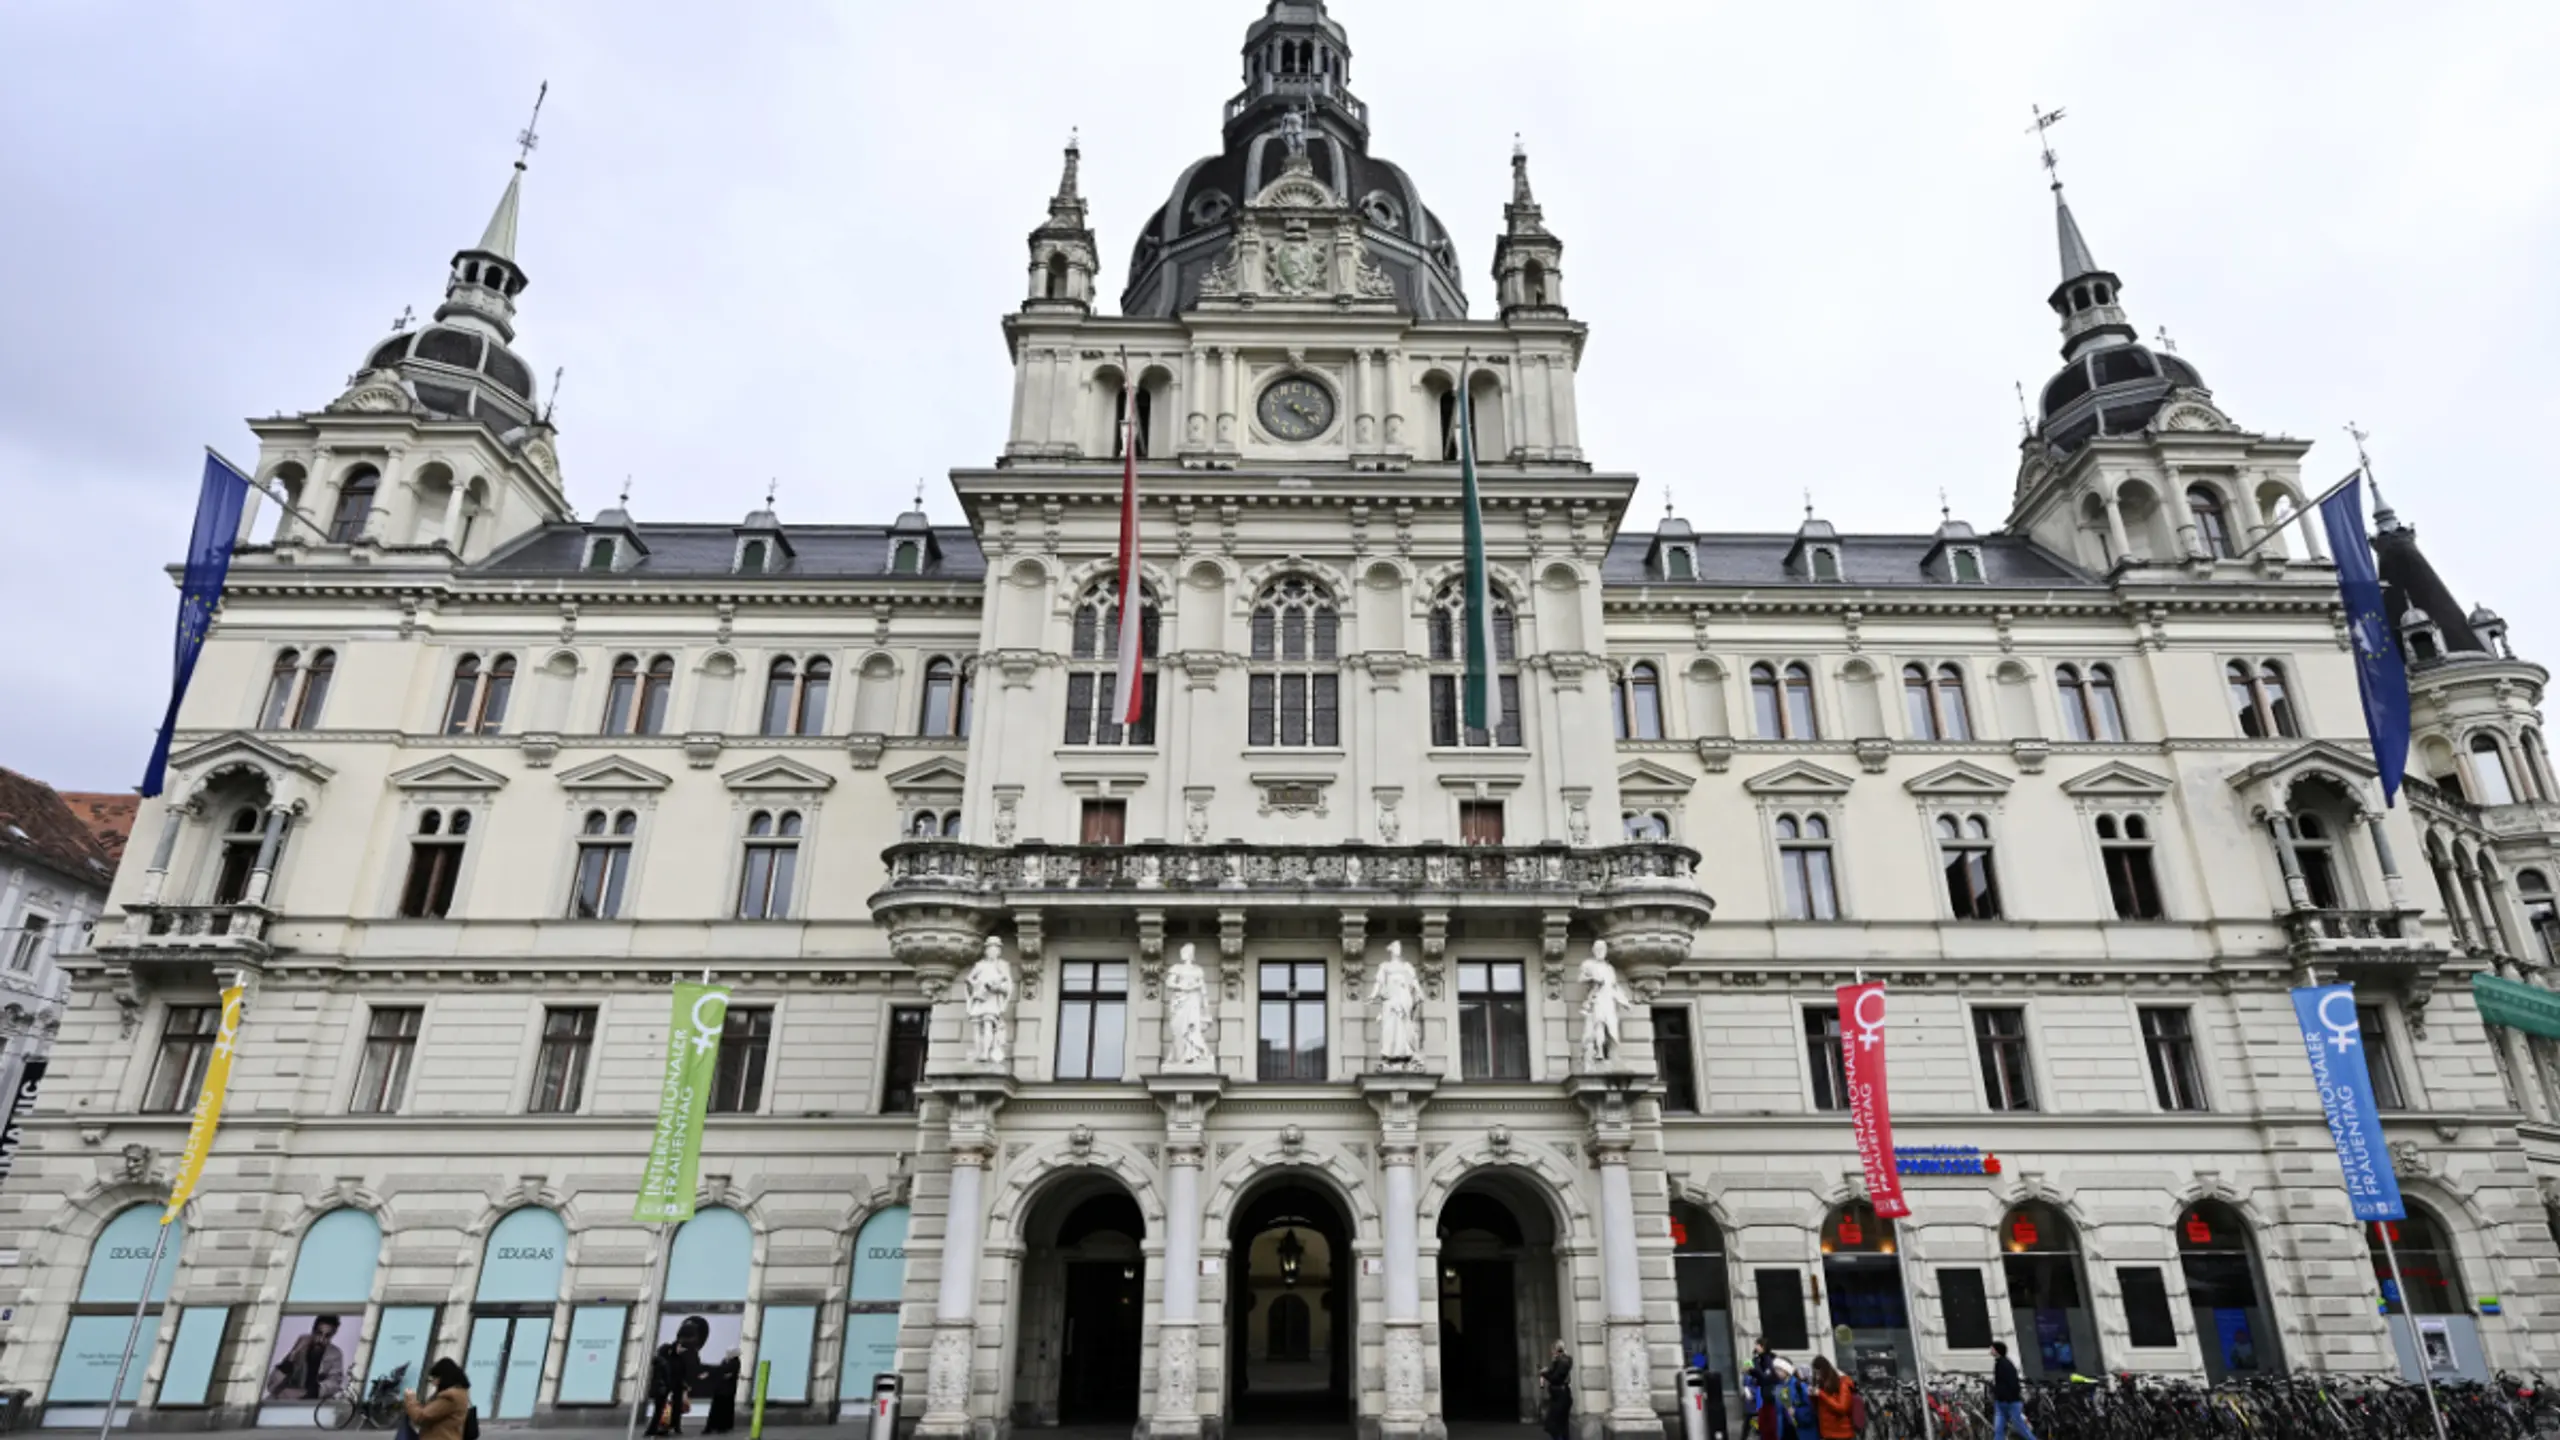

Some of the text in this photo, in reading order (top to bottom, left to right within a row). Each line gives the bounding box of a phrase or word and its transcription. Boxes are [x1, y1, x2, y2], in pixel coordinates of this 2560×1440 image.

[644, 1028, 688, 1197] INTERNATIONALER
[663, 1085, 695, 1197] FRAUENTAG
[1842, 1029, 1881, 1194] INTERNATIONALER
[2306, 1030, 2365, 1197] INTERNATIONALER
[2336, 1084, 2381, 1196] FRAUENTAG
[109, 1246, 168, 1260] DOUGLS
[497, 1246, 555, 1260] DOUGLAS
